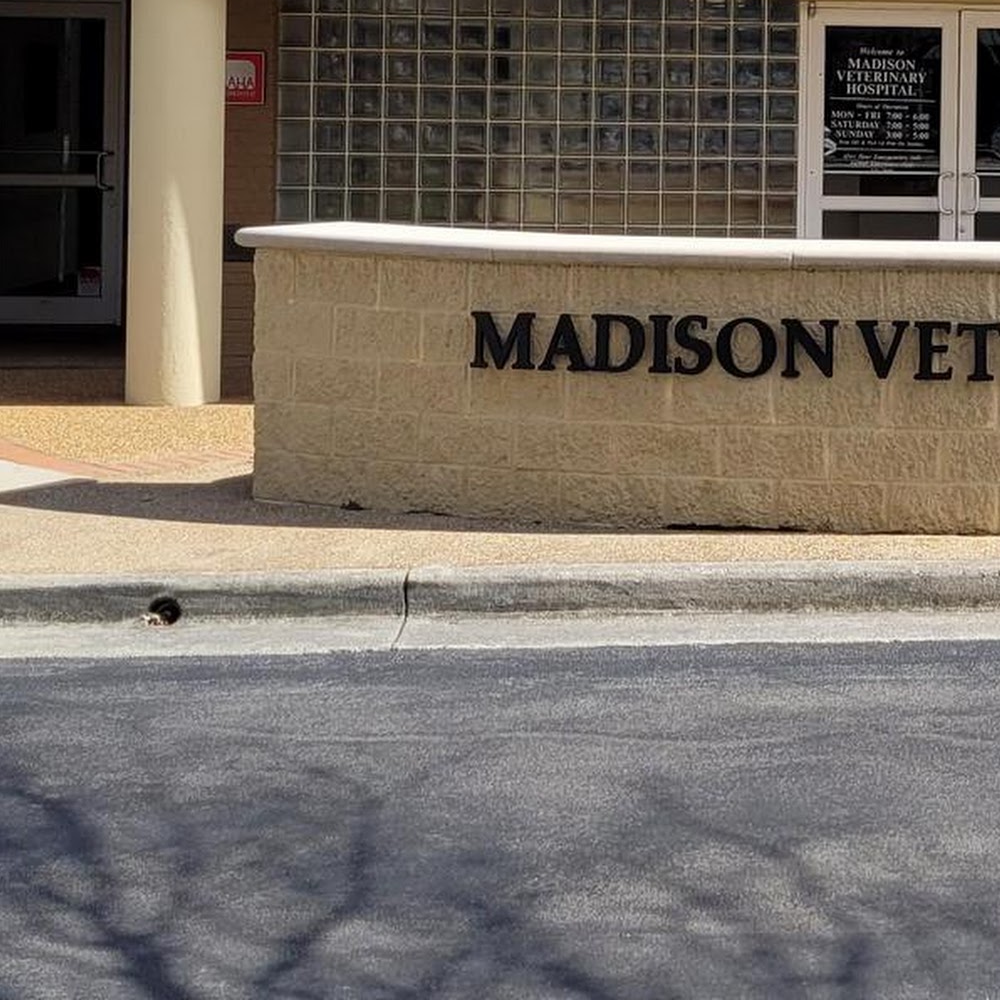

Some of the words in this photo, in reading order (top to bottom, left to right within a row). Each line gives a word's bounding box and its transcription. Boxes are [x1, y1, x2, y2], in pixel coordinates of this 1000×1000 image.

[847, 58, 916, 71] MADISON
[837, 69, 927, 83] VETERINARY
[846, 83, 917, 96] HOSPITAL
[830, 110, 855, 119] MON
[830, 120, 880, 129] SATURDAY
[836, 129, 875, 138] SUNDAY
[470, 311, 840, 379] MADISON
